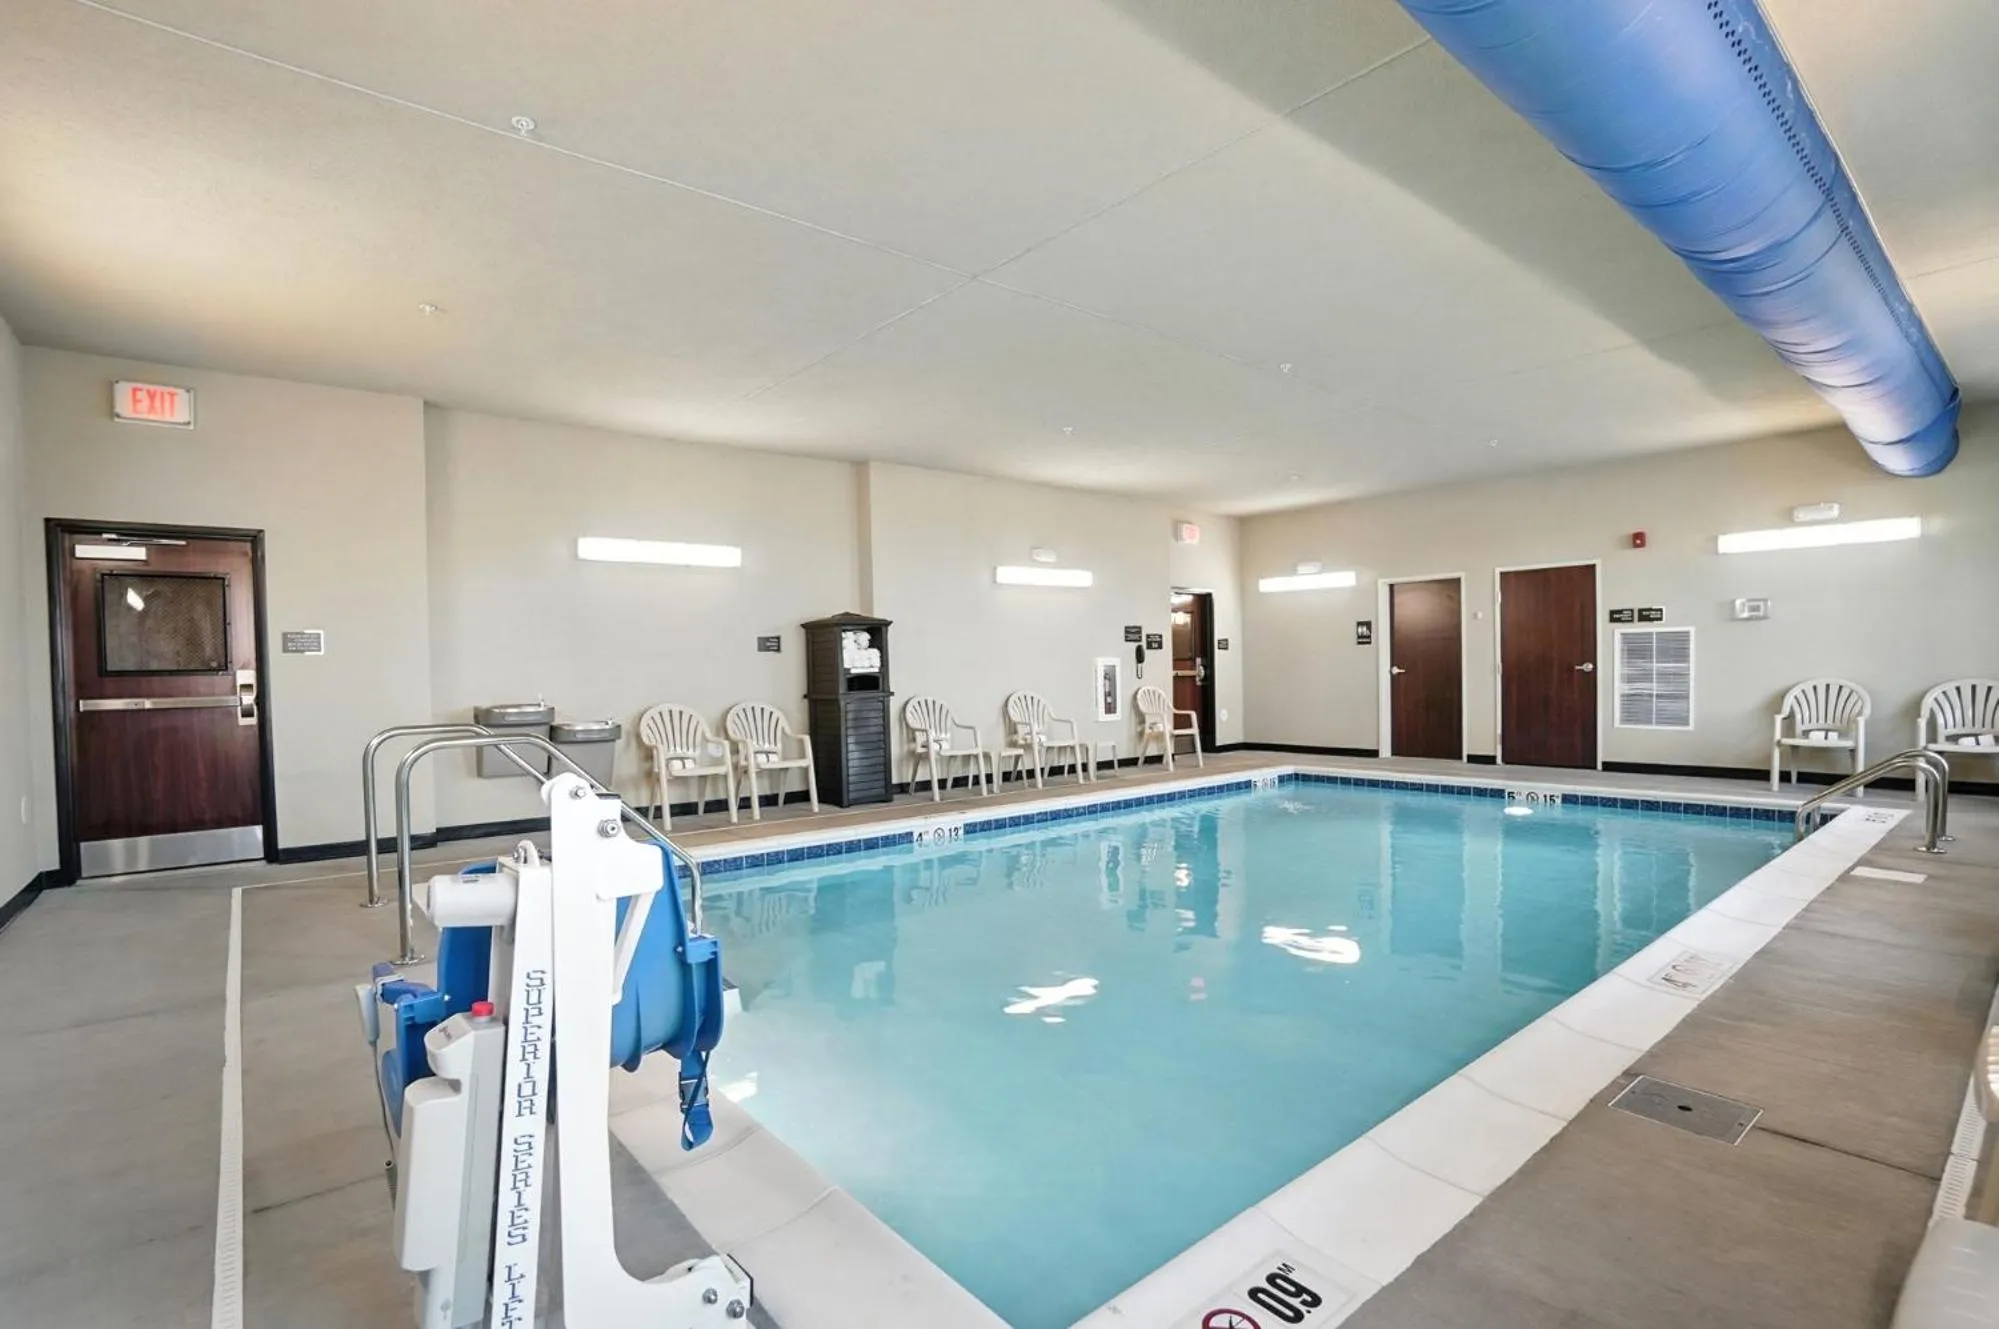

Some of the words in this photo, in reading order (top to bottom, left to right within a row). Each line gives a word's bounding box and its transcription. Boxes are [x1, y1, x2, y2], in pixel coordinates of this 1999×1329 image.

[131, 386, 178, 418] EXIT
[515, 970, 547, 1117] SUPERIOR
[507, 1134, 535, 1246] SERIES
